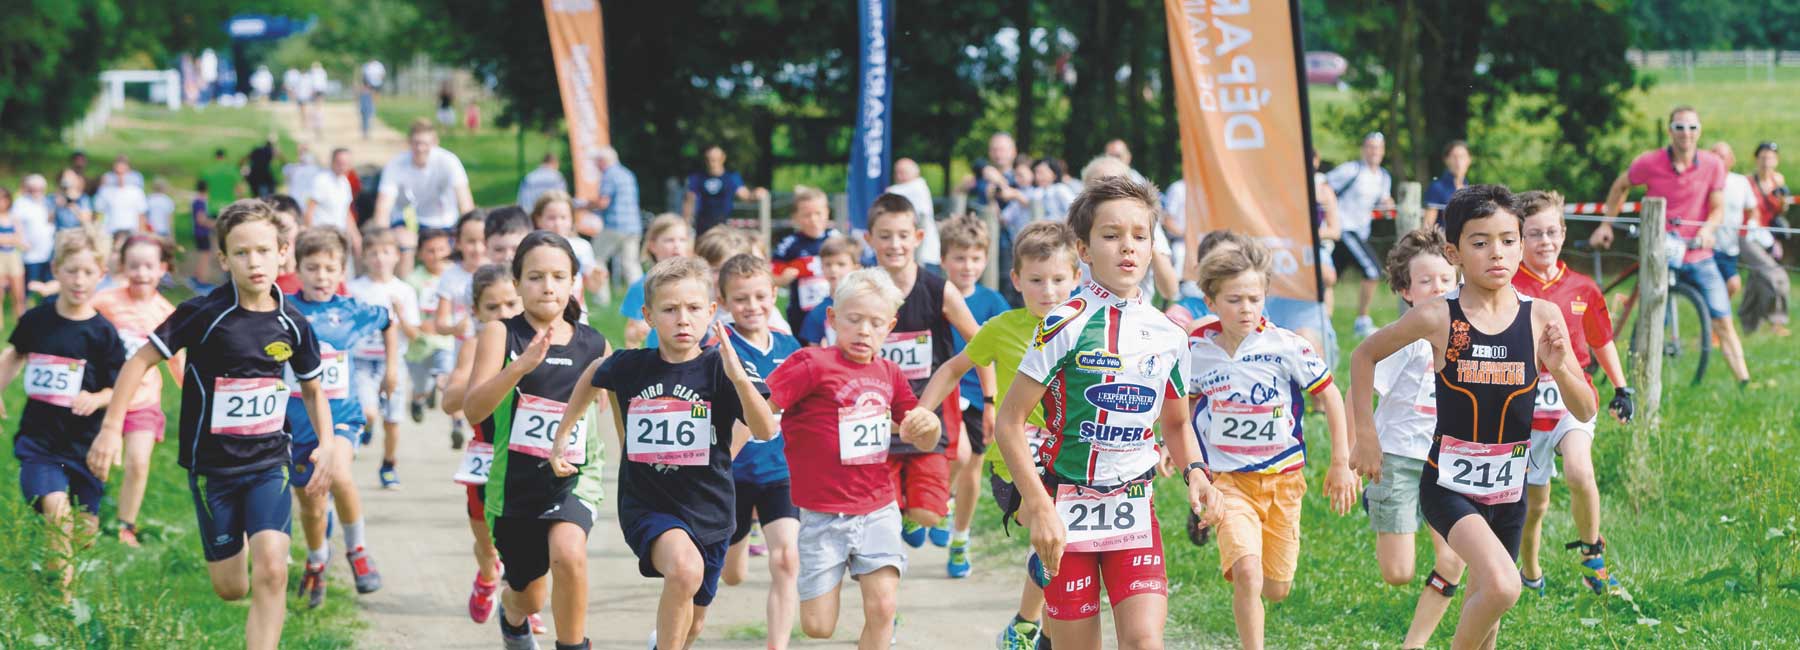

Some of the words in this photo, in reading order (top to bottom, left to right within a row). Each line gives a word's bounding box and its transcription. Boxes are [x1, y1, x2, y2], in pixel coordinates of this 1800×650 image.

[31, 367, 68, 390] 225
[1456, 368, 1525, 386] TRIATHLON
[226, 394, 277, 418] 210
[636, 417, 696, 447] 216
[853, 423, 886, 447] 21
[1081, 421, 1143, 442] SUPER
[1221, 416, 1276, 441] 224
[1452, 458, 1513, 488] 214
[1068, 501, 1136, 532] 218
